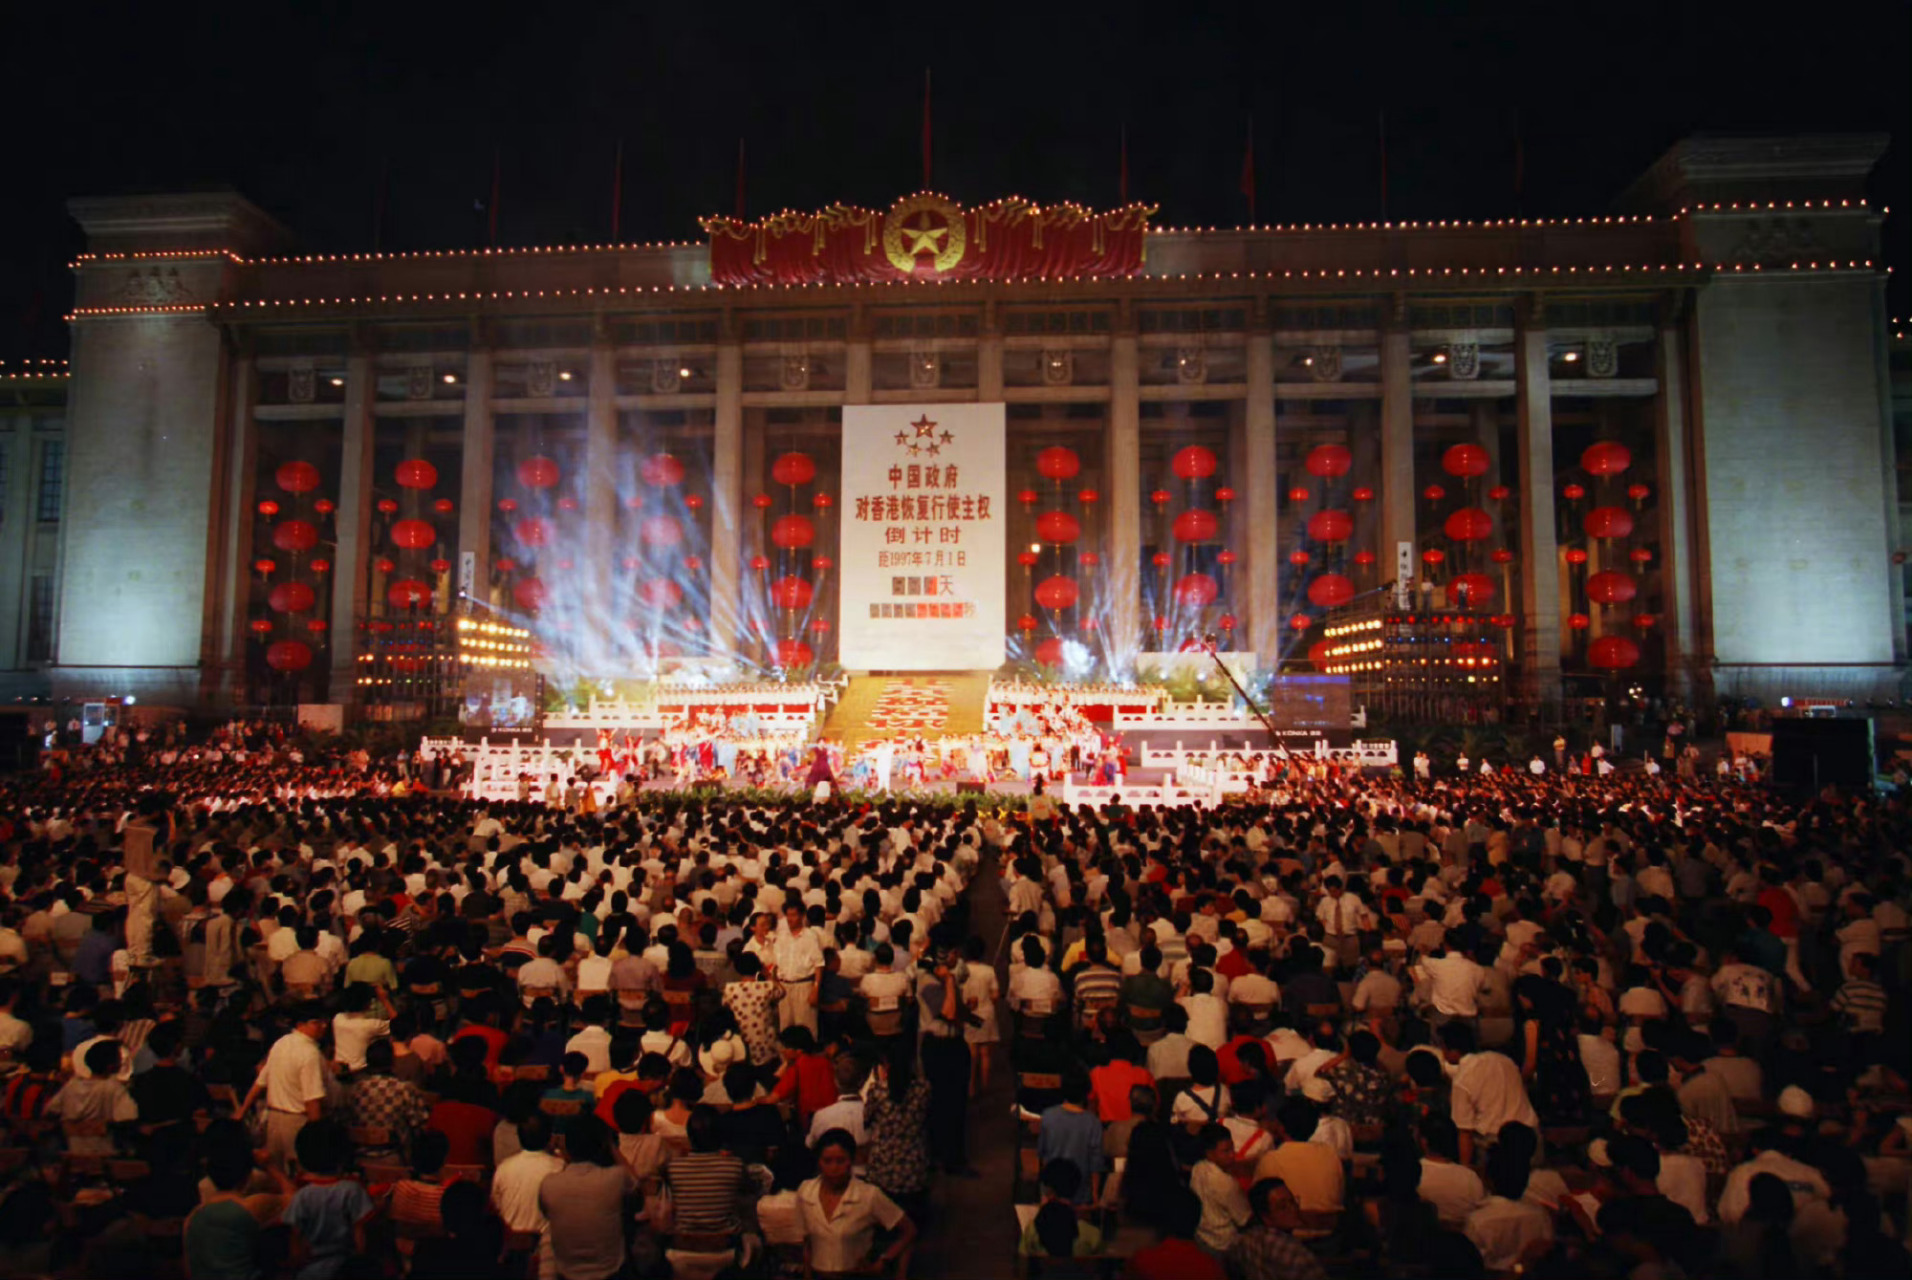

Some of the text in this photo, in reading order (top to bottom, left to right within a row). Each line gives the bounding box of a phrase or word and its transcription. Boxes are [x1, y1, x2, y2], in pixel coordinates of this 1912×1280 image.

[888, 464, 958, 489] 中国政府
[855, 494, 990, 521] 对香港恢复行使主权
[885, 526, 961, 544] 倒计时
